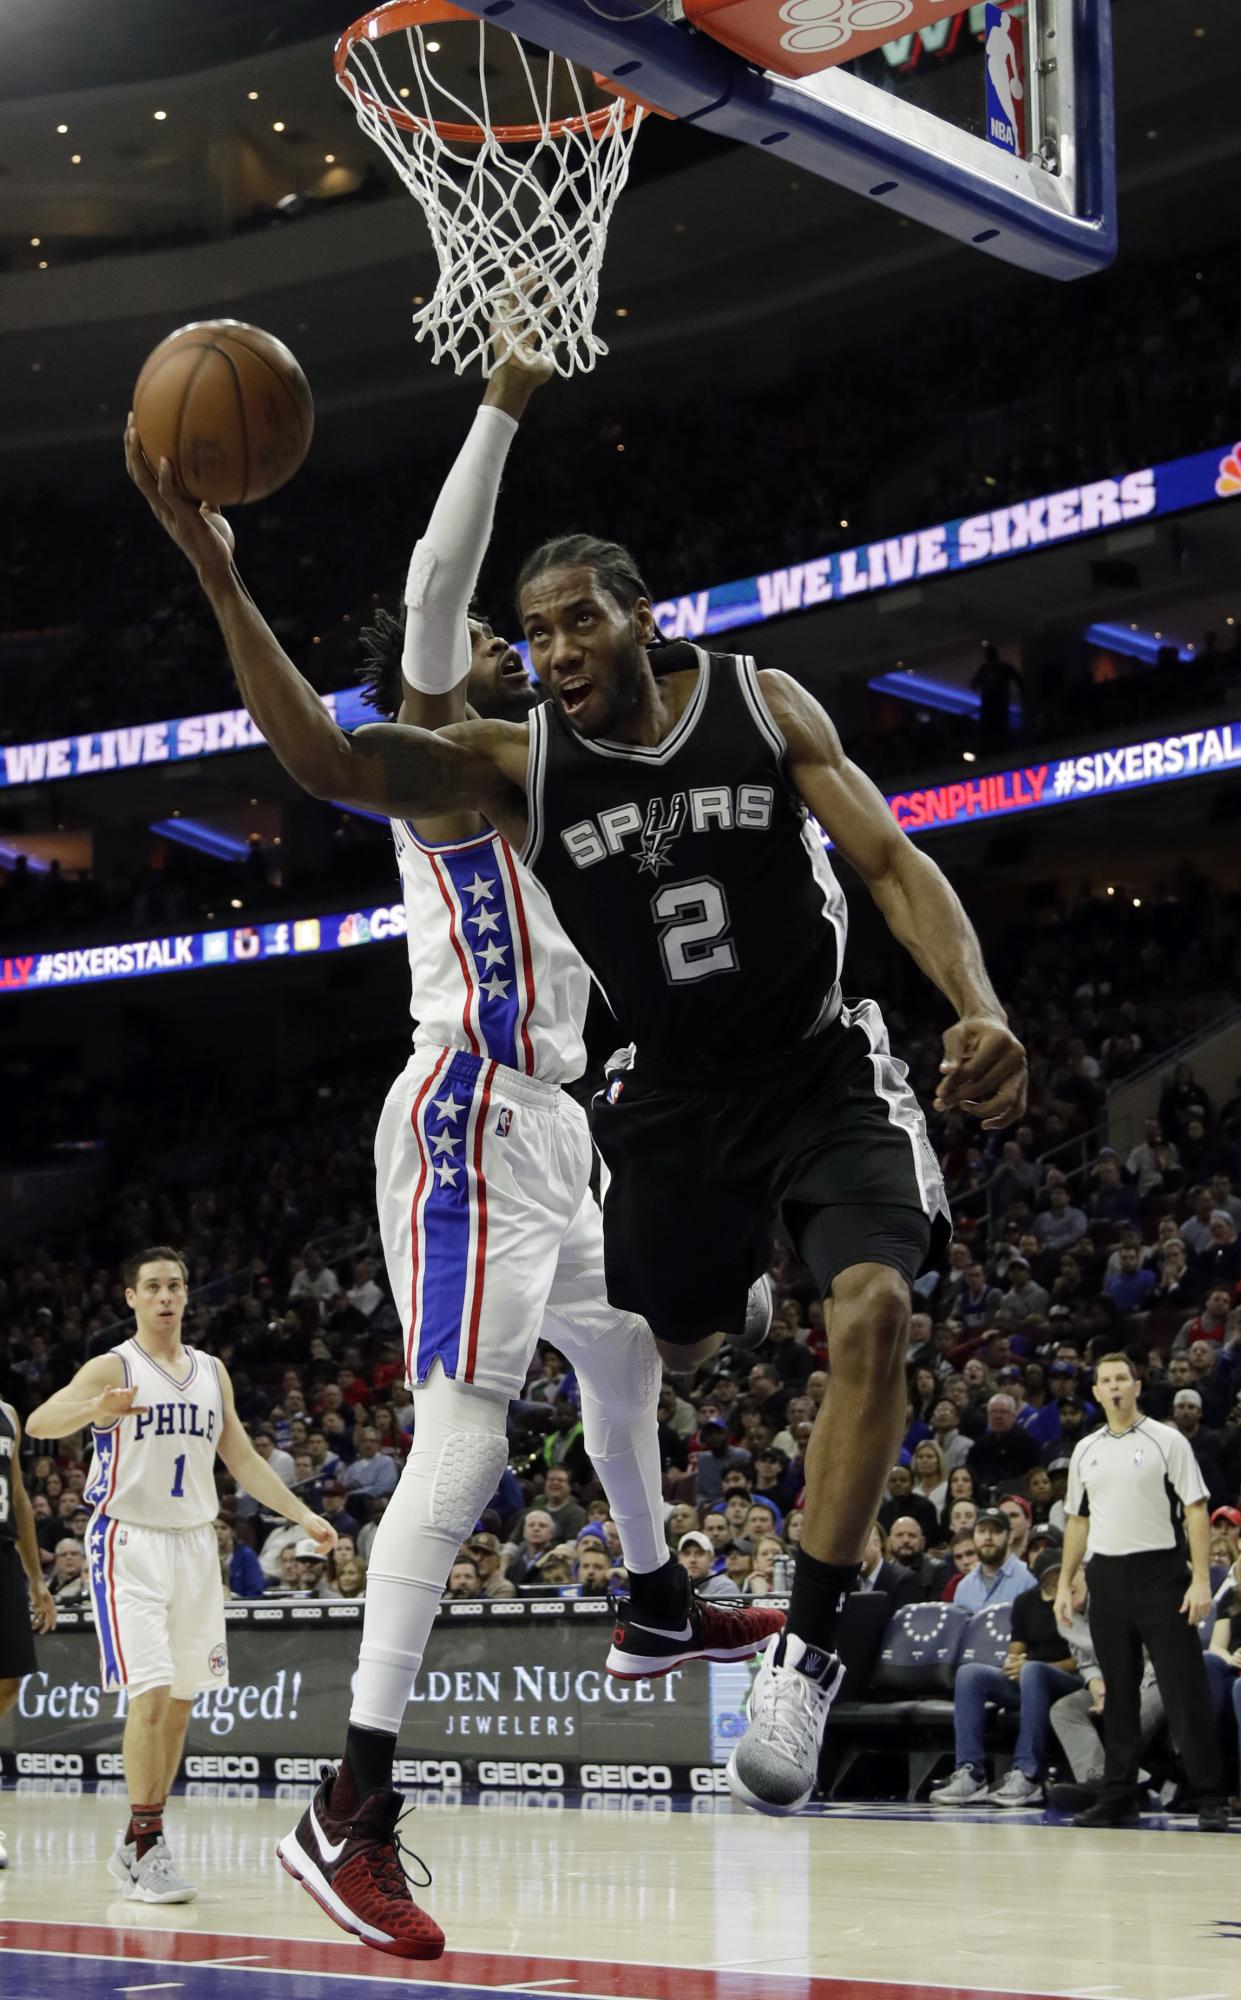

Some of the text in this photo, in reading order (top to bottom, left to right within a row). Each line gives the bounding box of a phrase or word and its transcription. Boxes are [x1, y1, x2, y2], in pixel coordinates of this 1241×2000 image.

[990, 118, 1014, 146] NBA
[757, 468, 1156, 617] WE LIVE SIXERS
[4, 708, 269, 783] WE LIVE SIX
[891, 766, 1048, 829] CSNPHILLY
[560, 784, 774, 877] SPURS
[650, 875, 741, 986] 2
[0, 936, 194, 988] LY #SIXERSTALK
[171, 1454, 186, 1498] 1
[450, 1604, 483, 1615] GEICO
[491, 1603, 524, 1614] GEICO
[531, 1602, 565, 1613] GEICO
[573, 1602, 608, 1613] GEICO
[18, 1671, 100, 1719] Gets
[514, 1666, 682, 1702] NUGGET
[445, 1715, 576, 1736] JEWELERS
[16, 1753, 83, 1775] GEICO
[185, 1756, 260, 1778] GEICO
[478, 1761, 565, 1787] GEICO
[580, 1764, 673, 1790] GEICO
[690, 1767, 731, 1793] GE
